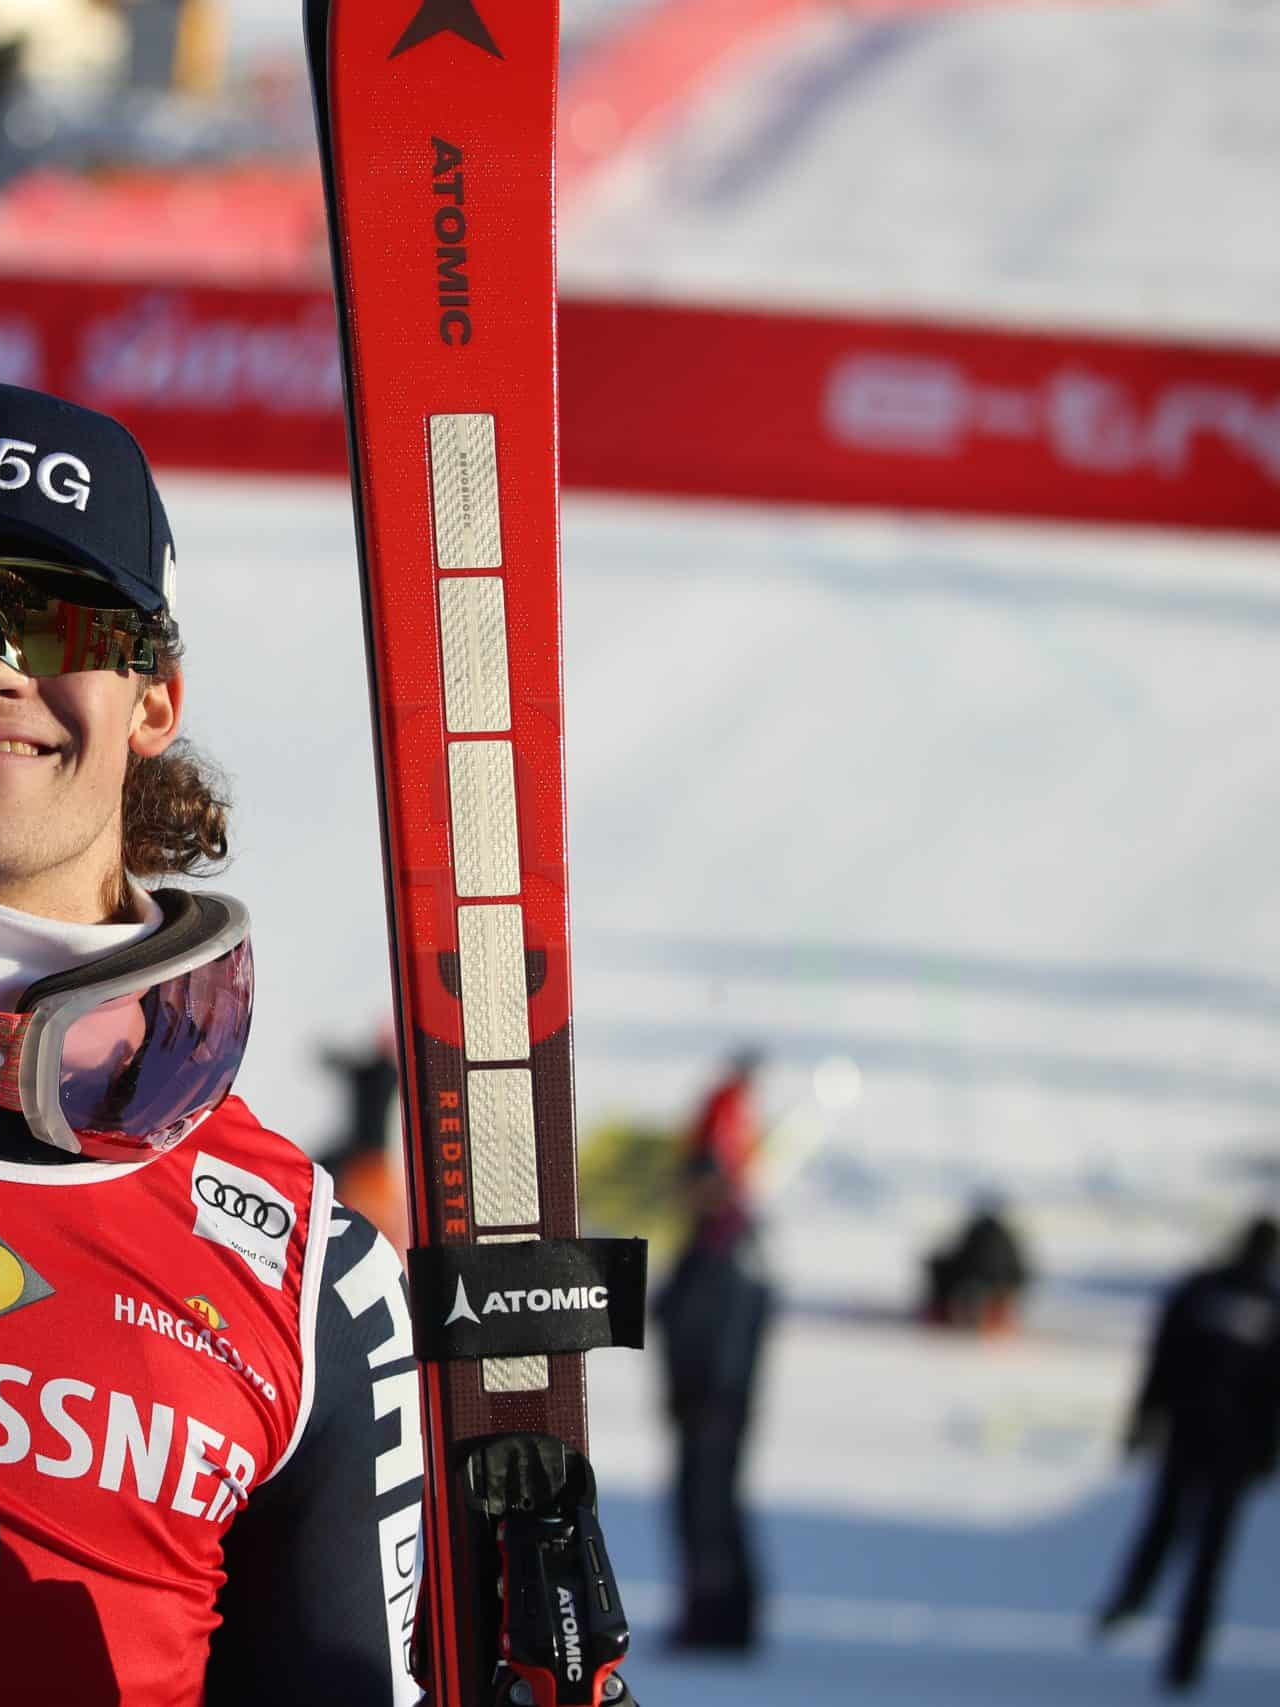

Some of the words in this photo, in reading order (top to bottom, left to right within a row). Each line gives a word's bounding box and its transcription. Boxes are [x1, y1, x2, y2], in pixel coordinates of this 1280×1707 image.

[431, 136, 472, 346] ATOMIC
[259, 1254, 279, 1270] Cup
[482, 1286, 608, 1315] ATOMIC
[557, 1586, 582, 1682] ATOMIC
